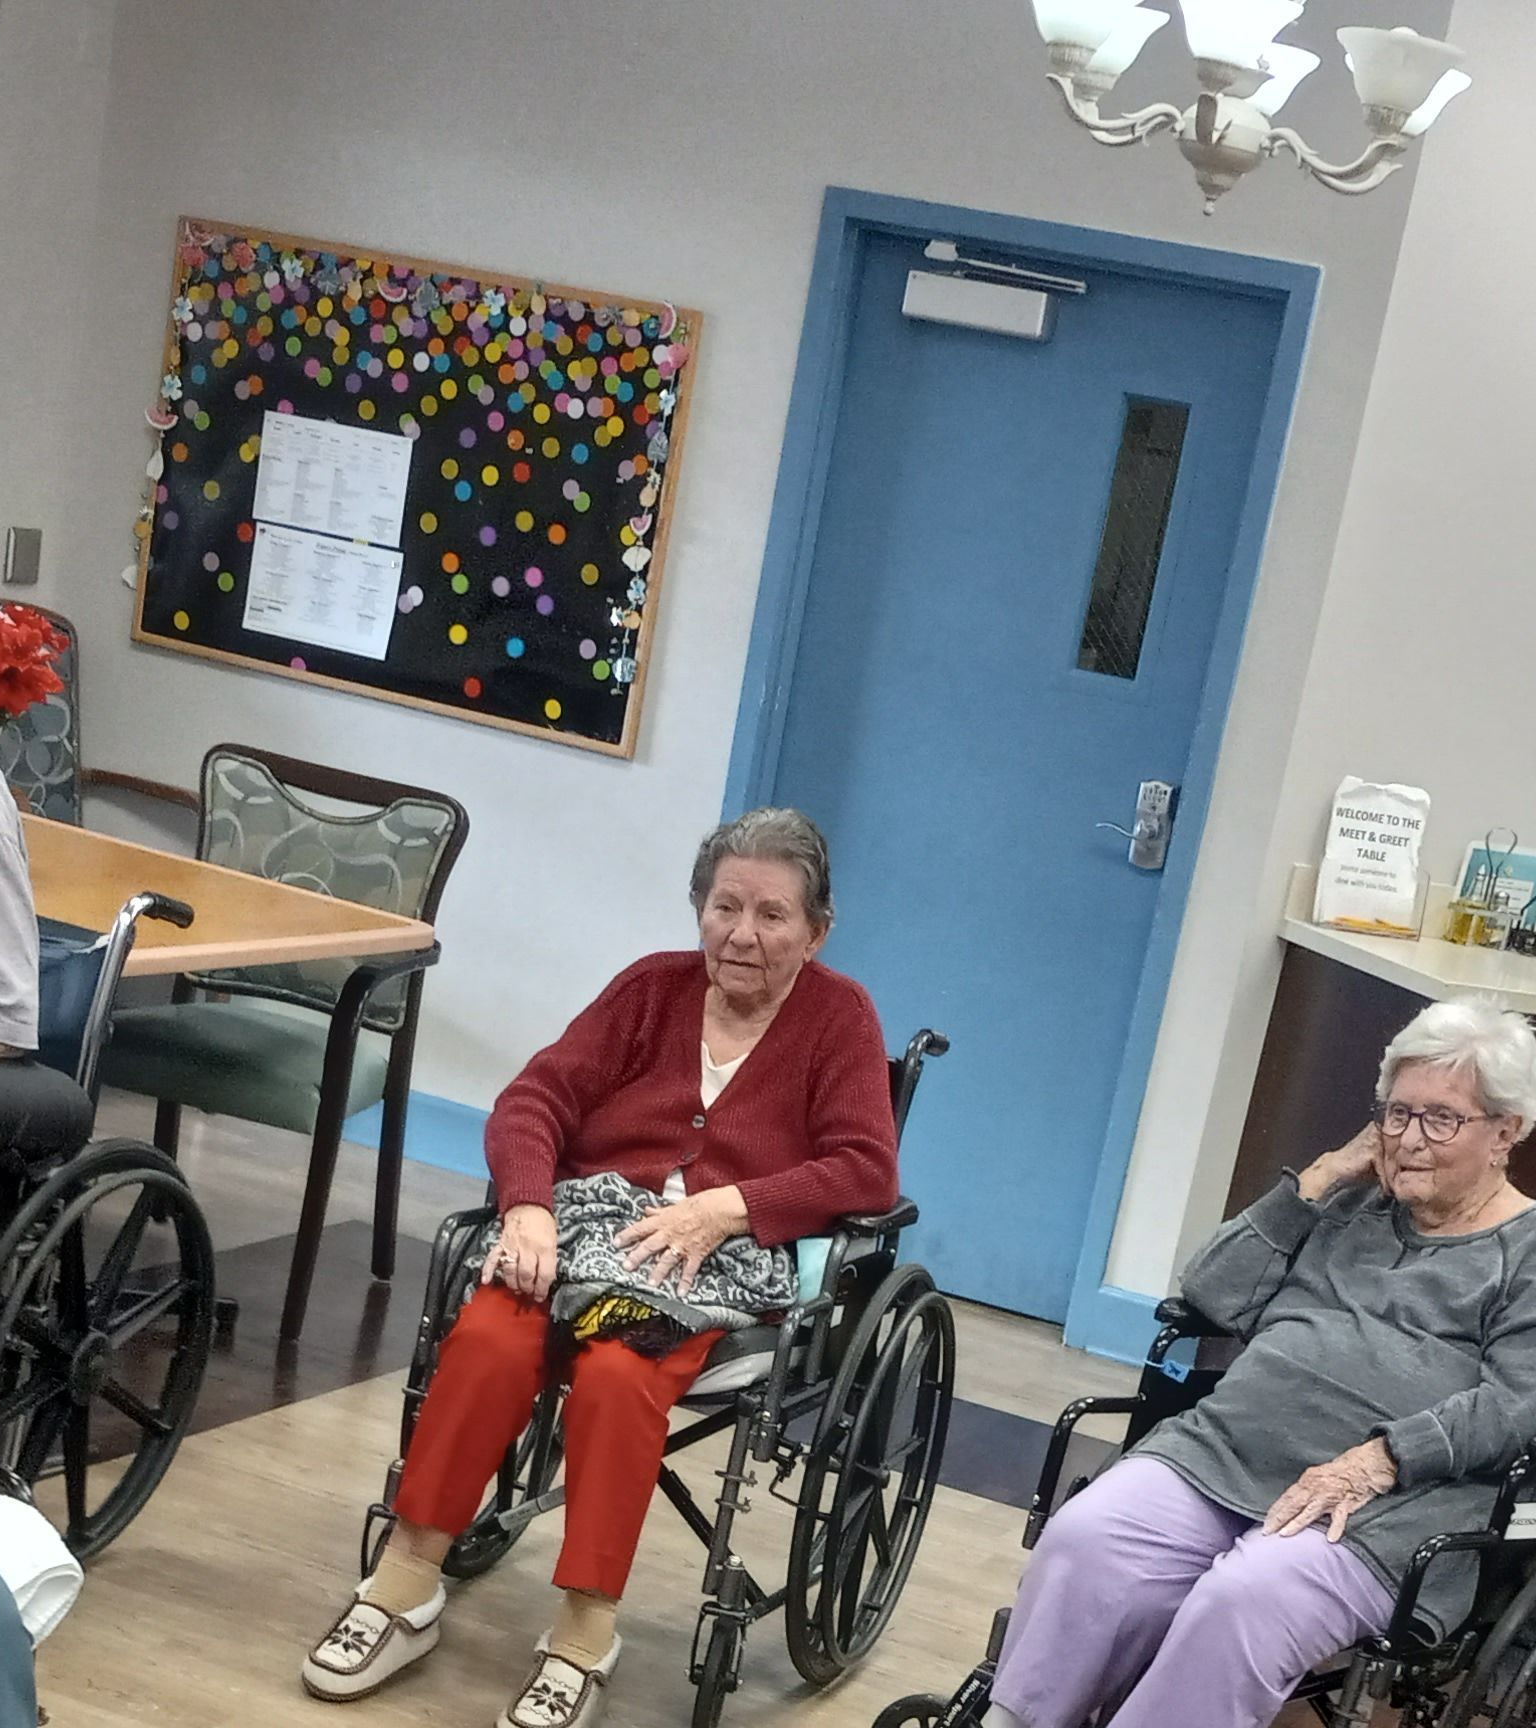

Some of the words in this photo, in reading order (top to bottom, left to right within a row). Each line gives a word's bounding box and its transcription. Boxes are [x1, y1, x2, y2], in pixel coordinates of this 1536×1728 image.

[1336, 807, 1385, 824] WELCOME
[1386, 814, 1400, 826] TO
[1402, 817, 1422, 830] THE
[1339, 827, 1366, 840] MEET
[1368, 831, 1377, 842] &
[1379, 833, 1410, 847] GREET
[1357, 848, 1387, 862] TABLE
